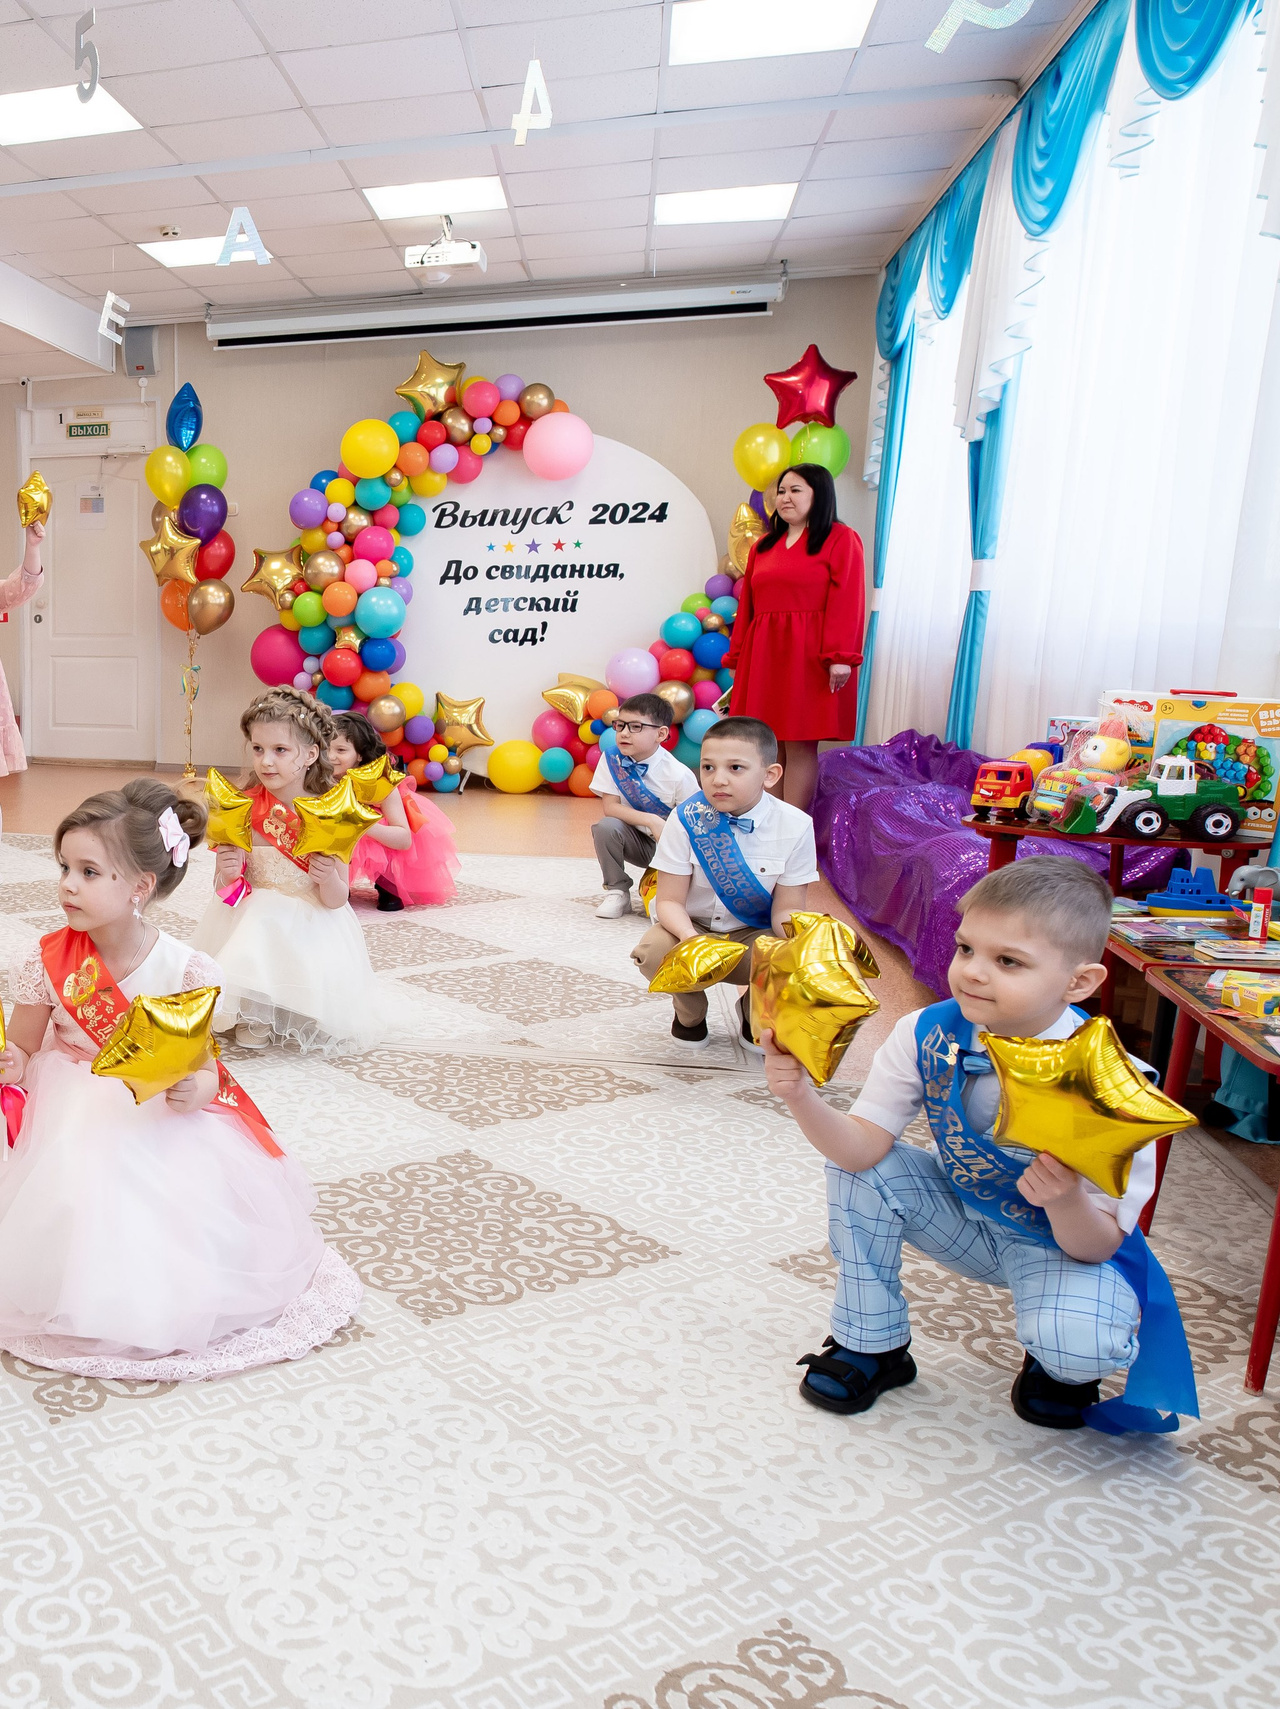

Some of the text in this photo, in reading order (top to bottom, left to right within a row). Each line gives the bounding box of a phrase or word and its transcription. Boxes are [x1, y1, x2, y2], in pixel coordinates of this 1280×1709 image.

[75, 7, 99, 104] 5
[71, 425, 107, 436] ВЫХОД
[432, 500, 669, 534] Выпуск 2024
[439, 560, 625, 585] До свидания,
[463, 590, 579, 616] детский
[488, 621, 548, 646] сад!
[694, 837, 738, 898] ДЕТСКОГО
